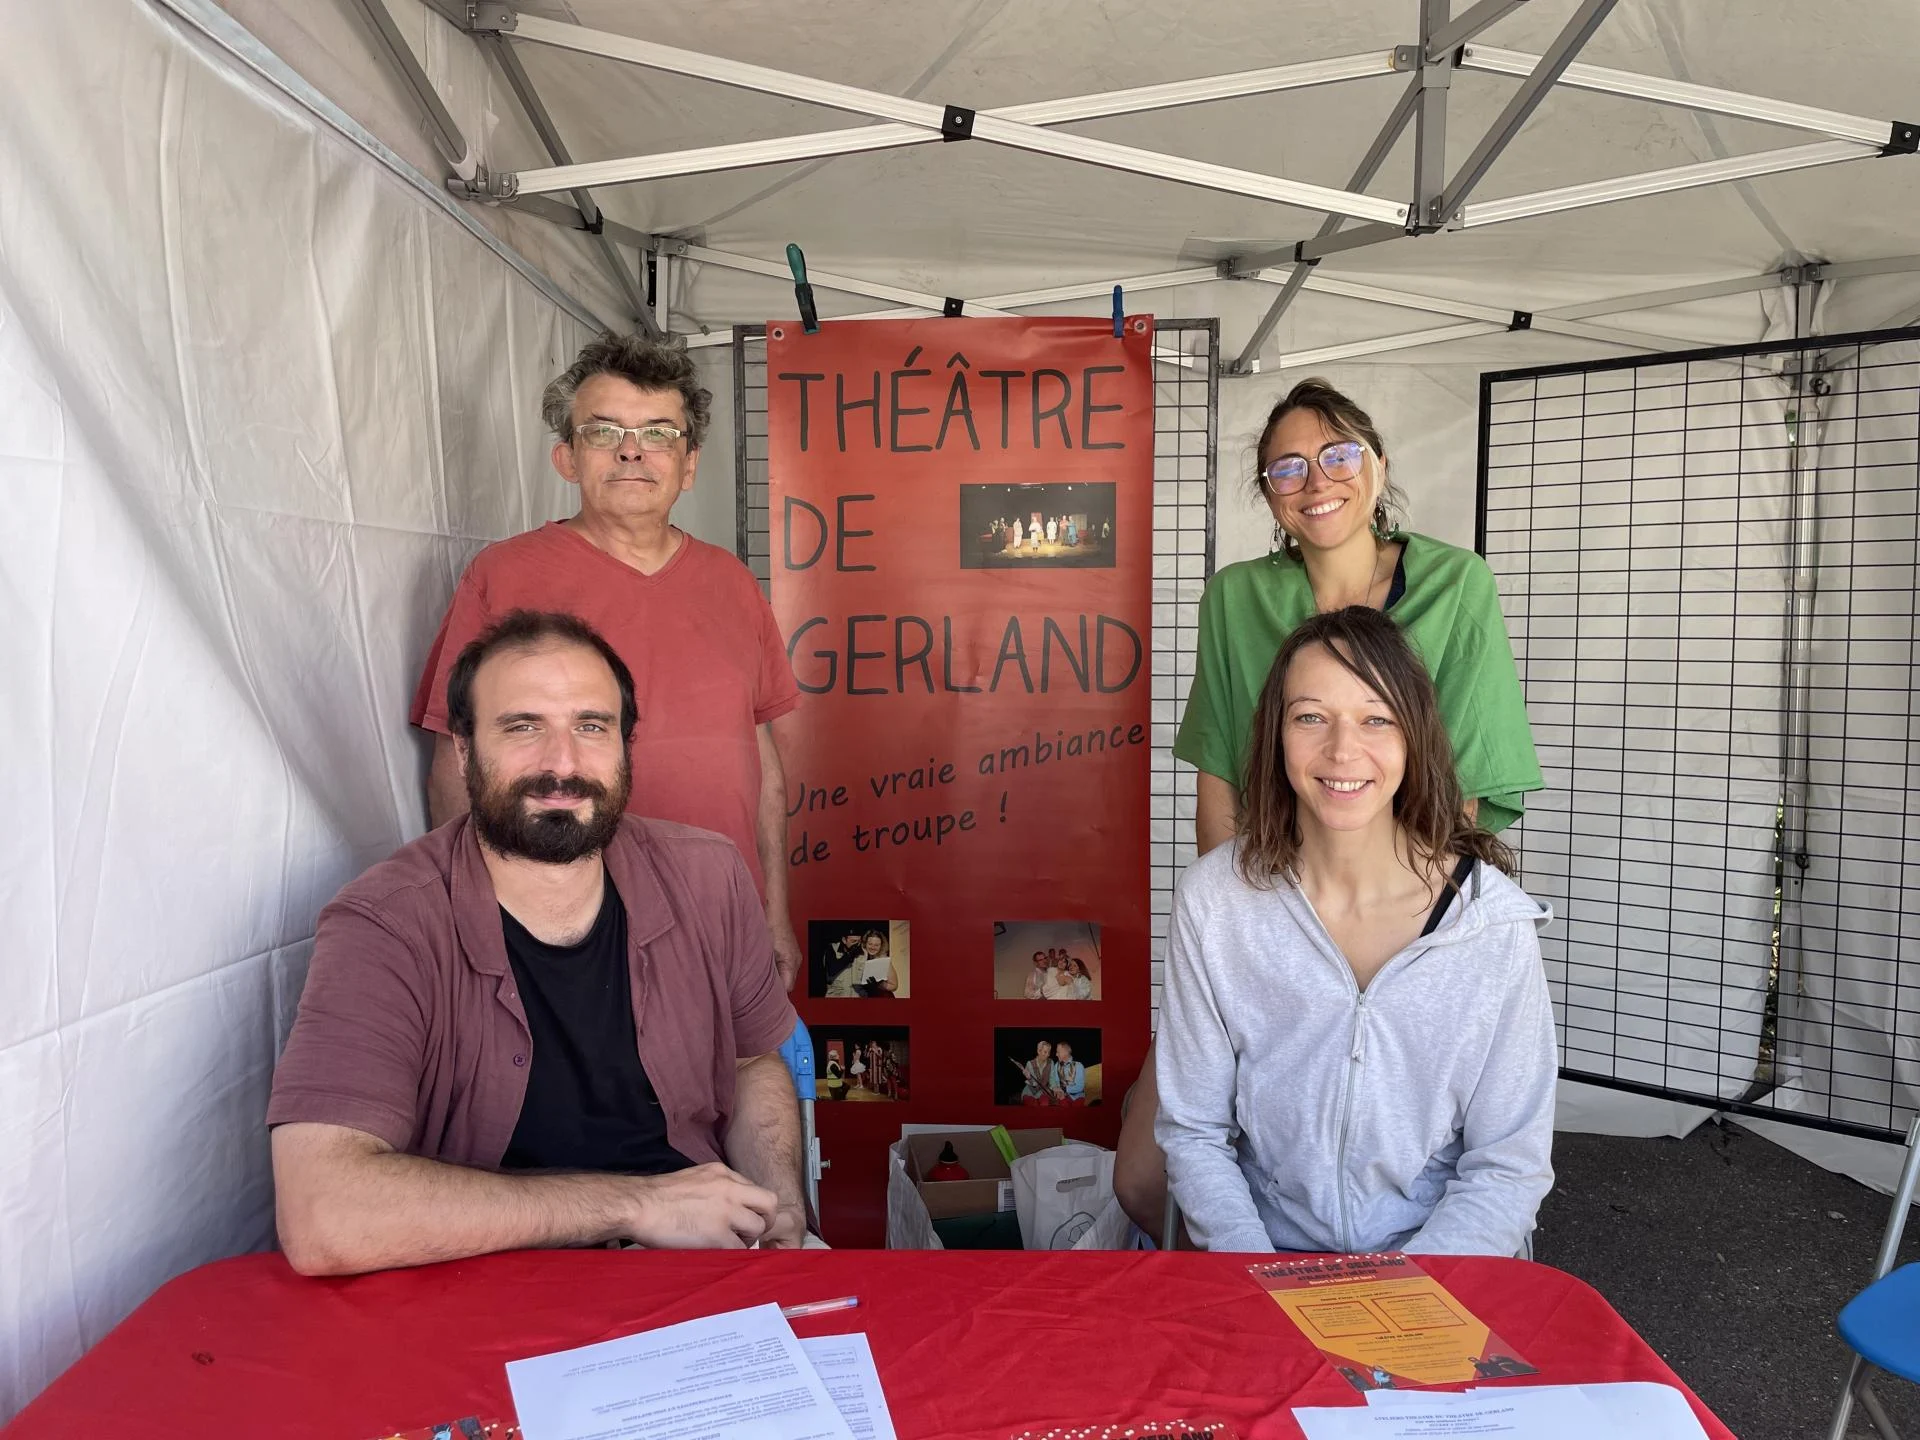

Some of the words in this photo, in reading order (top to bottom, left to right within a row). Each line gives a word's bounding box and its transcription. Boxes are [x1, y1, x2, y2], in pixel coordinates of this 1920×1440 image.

[778, 345, 1126, 453] THÉÂTRE
[784, 494, 877, 572] DE
[787, 613, 1143, 696] GERLAND
[870, 757, 956, 798] vraie
[978, 723, 1146, 775] ambiance
[790, 831, 831, 867] de
[852, 810, 977, 852] troupe
[999, 790, 1008, 823] !
[1325, 1262, 1343, 1272] DE
